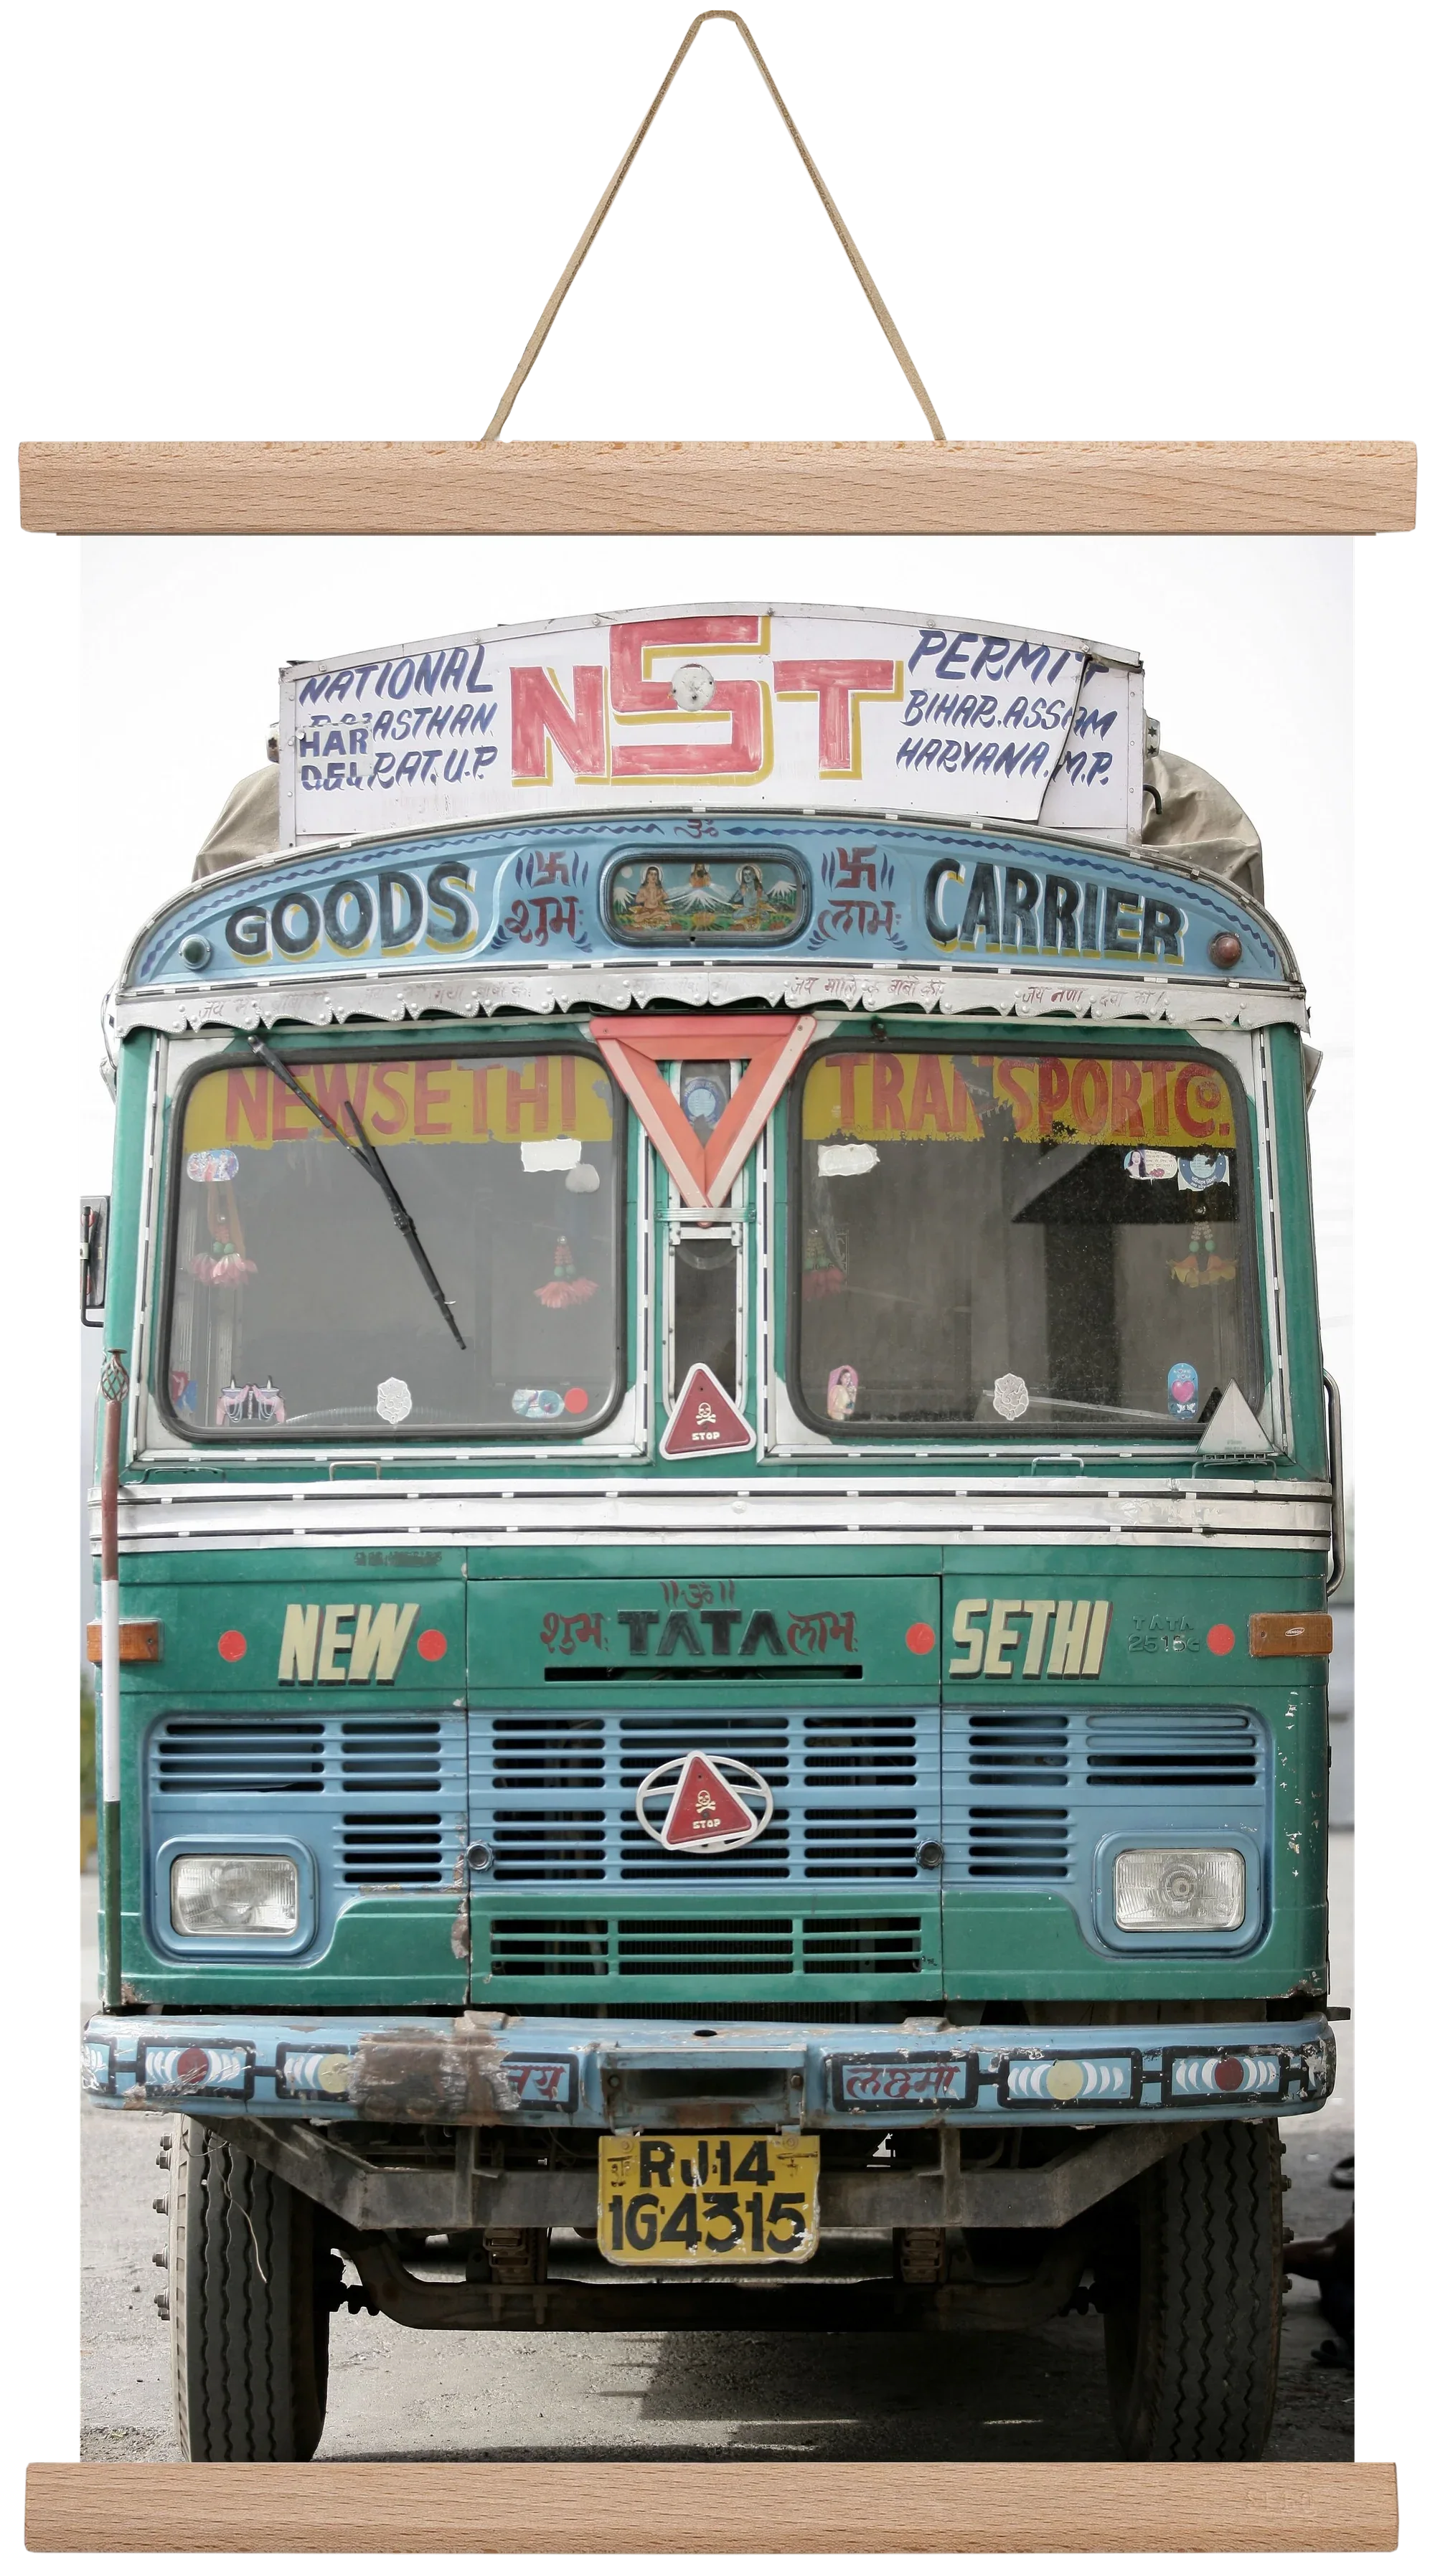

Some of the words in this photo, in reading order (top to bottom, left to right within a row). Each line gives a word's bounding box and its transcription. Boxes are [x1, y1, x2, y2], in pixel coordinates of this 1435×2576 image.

[298, 644, 494, 707] NATIONAL
[510, 615, 903, 787] NST
[300, 727, 370, 758] HAR
[225, 861, 479, 965] GOODS
[924, 858, 1188, 967] CARRIER
[692, 1431, 720, 1441] STOP
[278, 1603, 420, 1686] NEW
[617, 1609, 788, 1656] TATA
[949, 1598, 1114, 1680] SETHI
[1133, 1613, 1195, 1631] TATA
[692, 1818, 721, 1829] STOP
